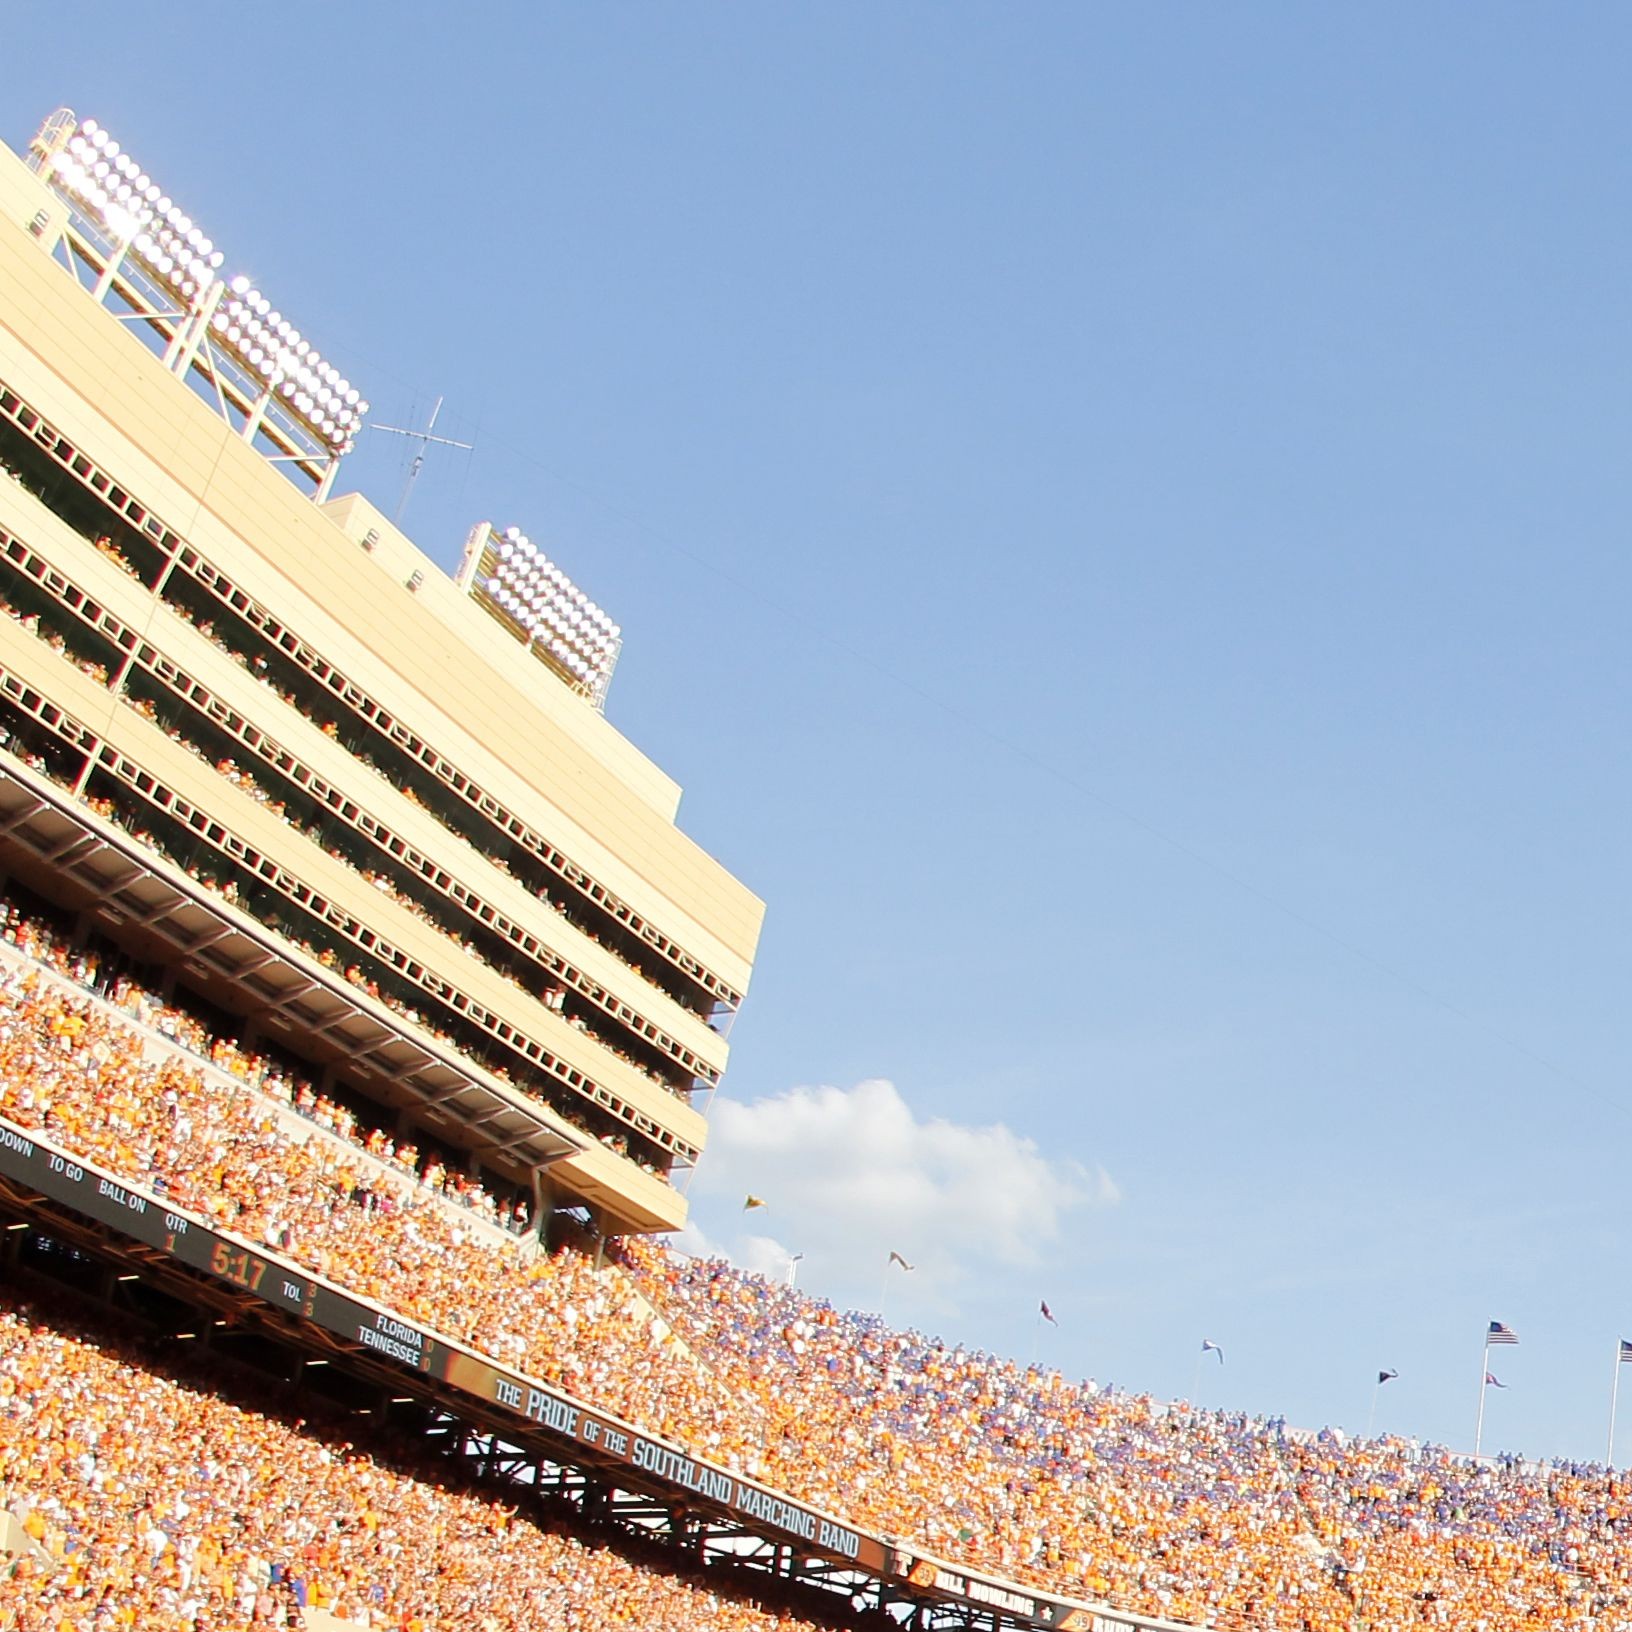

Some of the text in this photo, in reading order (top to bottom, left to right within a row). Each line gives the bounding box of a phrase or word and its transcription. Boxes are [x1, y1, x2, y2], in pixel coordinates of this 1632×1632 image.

[0, 1127, 34, 1158] DOWN
[49, 1154, 84, 1182] TO GO
[99, 1180, 147, 1214] BALL ON
[165, 1213, 188, 1234] QTR
[163, 1233, 176, 1253] 1
[210, 1242, 267, 1291] 5:17
[282, 1280, 301, 1302] TOL
[358, 1325, 420, 1367] TENNESSEE
[376, 1315, 423, 1348] FLORIDA
[496, 1379, 860, 1559] THE PRIDE OF THE SOUTHLAND MARCHING BAND
[967, 1580, 1035, 1617] NOWLING
